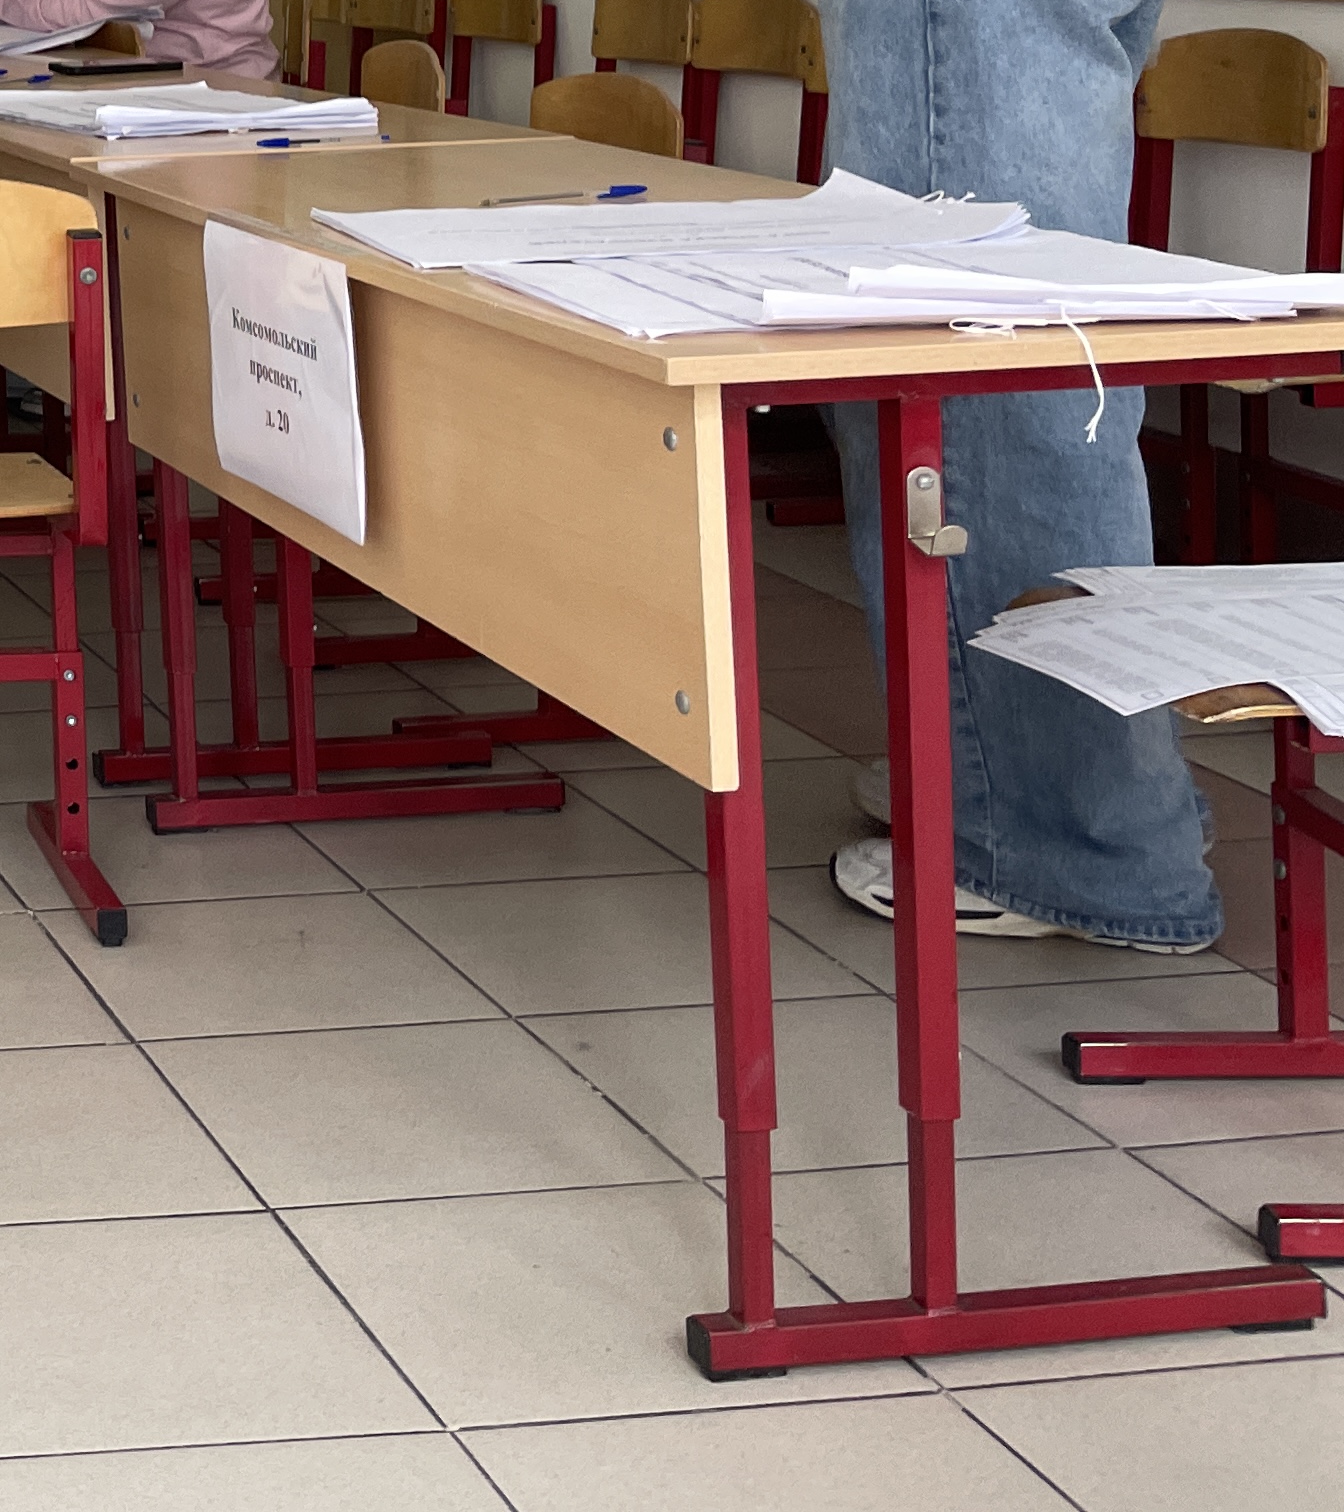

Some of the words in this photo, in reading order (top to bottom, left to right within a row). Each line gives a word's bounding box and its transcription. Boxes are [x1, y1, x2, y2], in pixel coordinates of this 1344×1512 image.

[232, 306, 318, 362] Комсомольский
[249, 359, 303, 400] проспект,
[277, 409, 290, 435] 20
